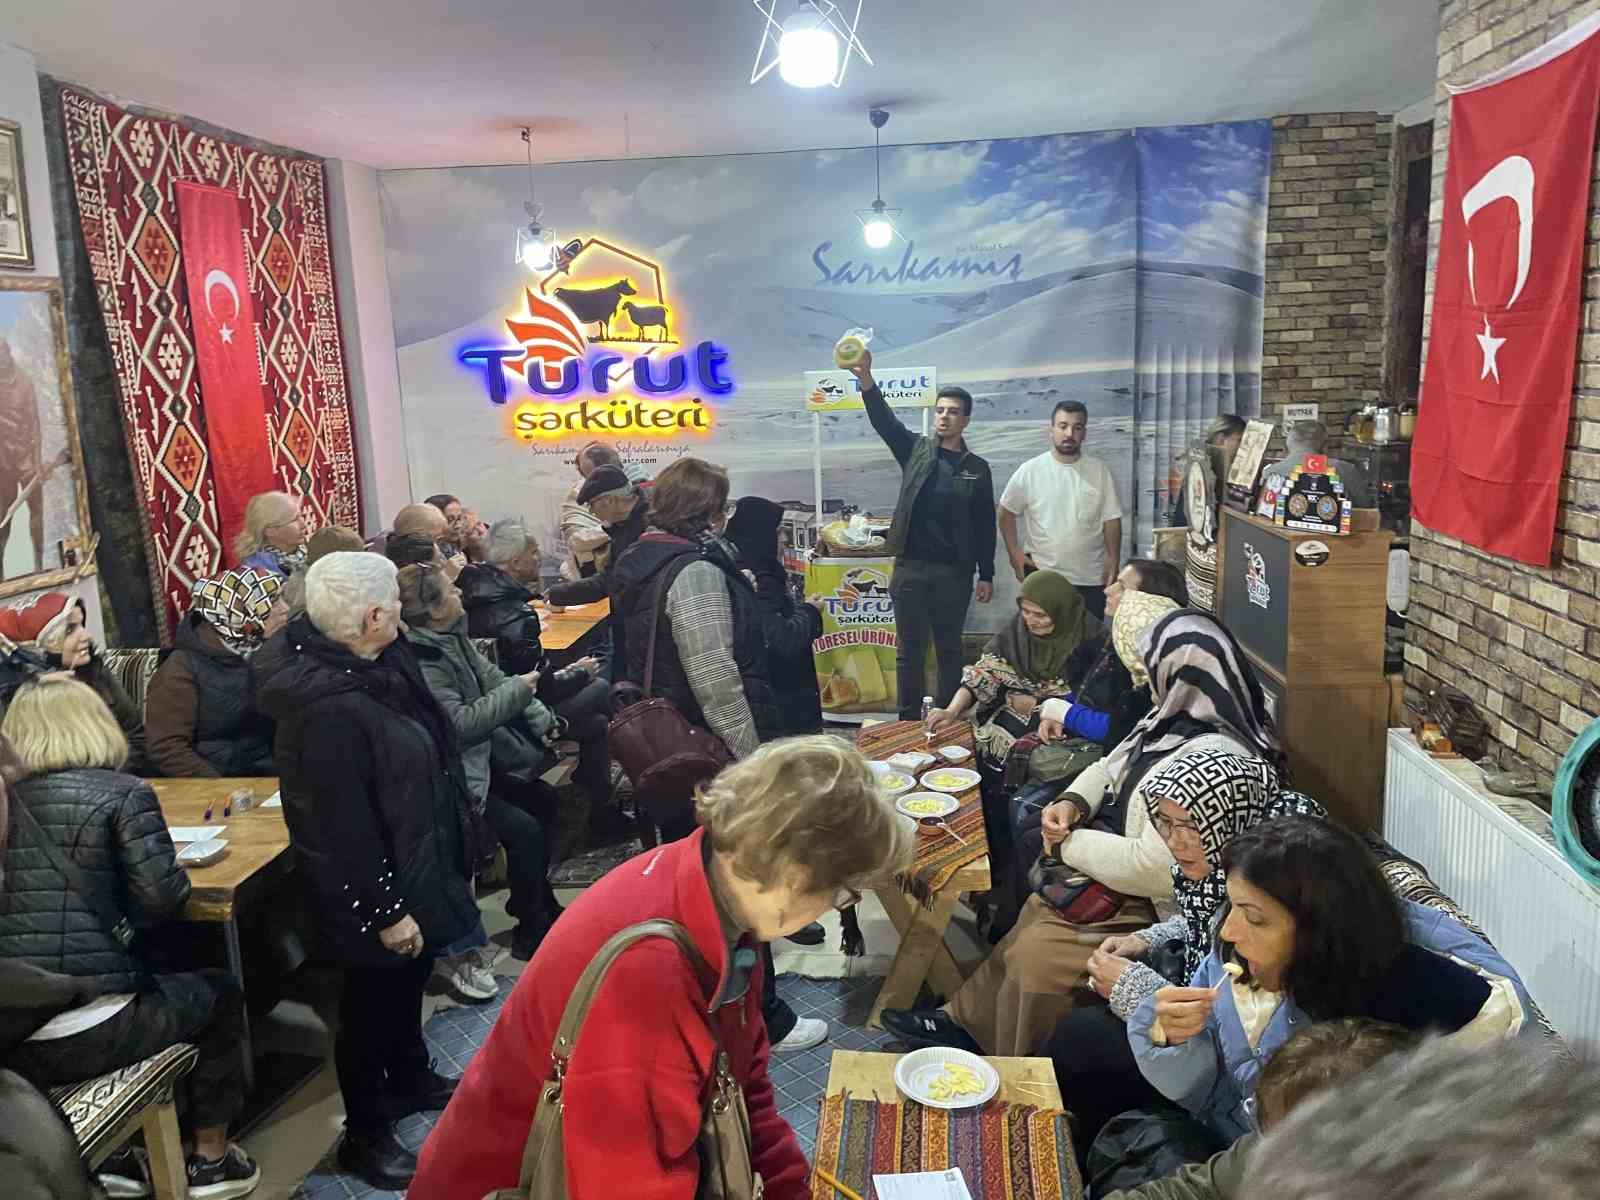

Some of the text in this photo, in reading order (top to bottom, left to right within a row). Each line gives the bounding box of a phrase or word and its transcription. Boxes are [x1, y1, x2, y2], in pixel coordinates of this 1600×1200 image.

[461, 341, 733, 404] Turut
[848, 375, 929, 392] Trut
[882, 389, 922, 399] küteri
[516, 398, 710, 439] şarküteri
[823, 598, 893, 613] Turu
